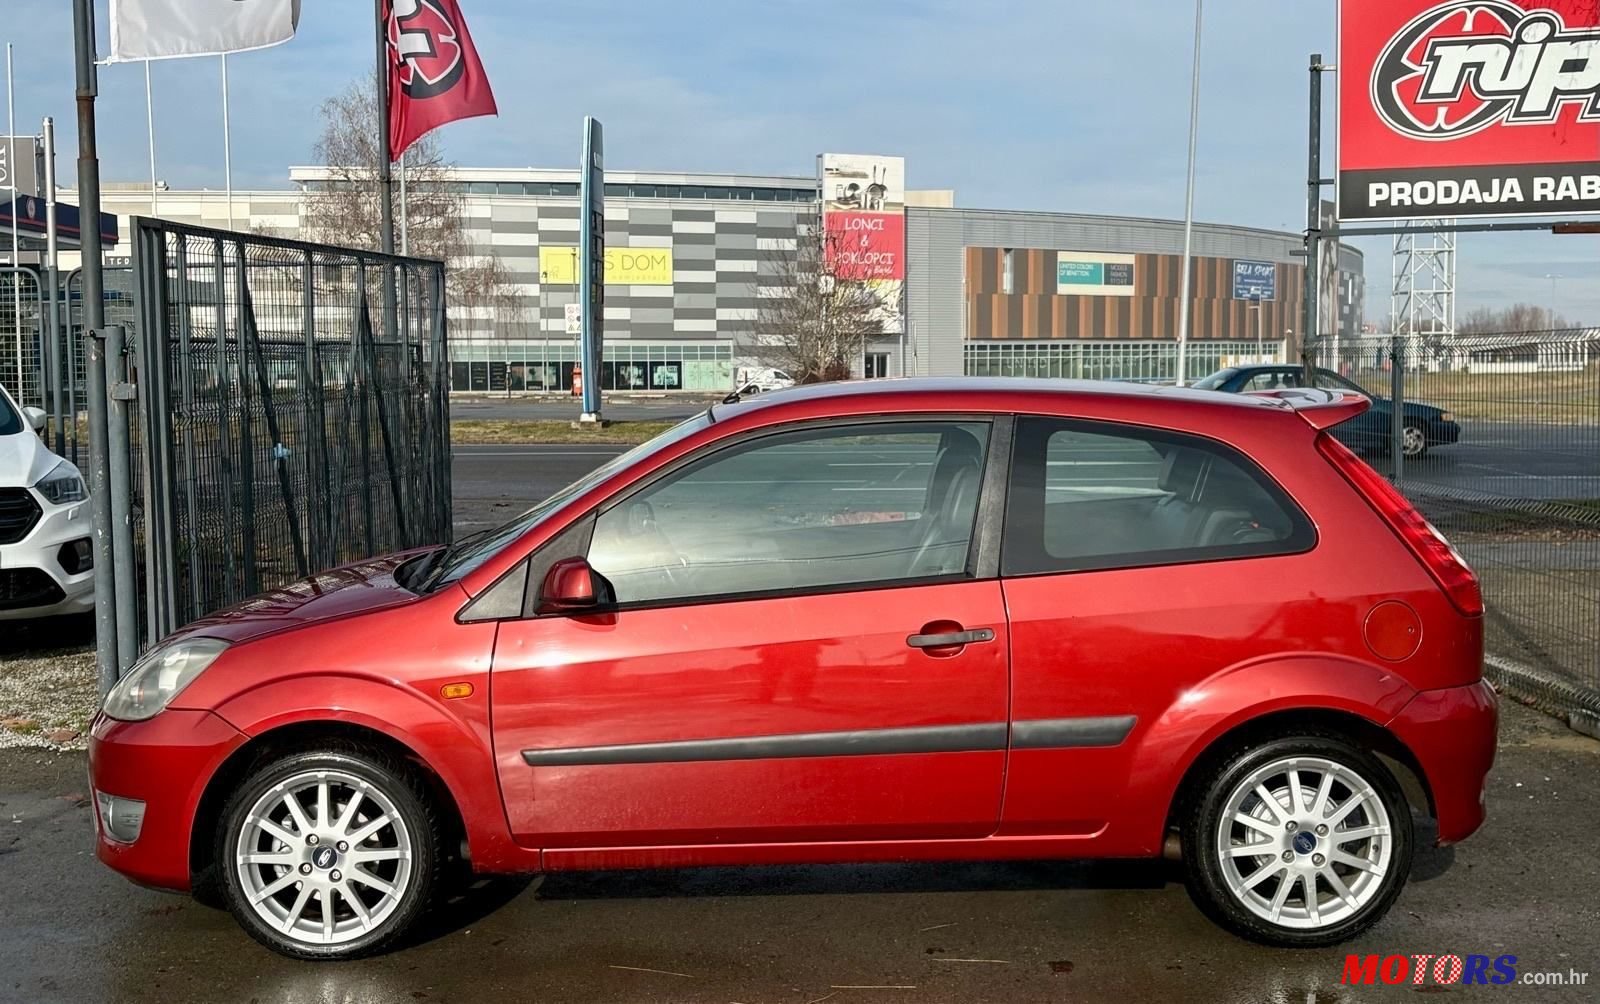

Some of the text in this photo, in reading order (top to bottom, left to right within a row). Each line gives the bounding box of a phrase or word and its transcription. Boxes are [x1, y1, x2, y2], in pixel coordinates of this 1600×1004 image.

[1368, 175, 1600, 207] PRODAJA RAB
[845, 218, 884, 231] LONCI
[860, 235, 869, 247] &
[621, 254, 666, 271] DOM
